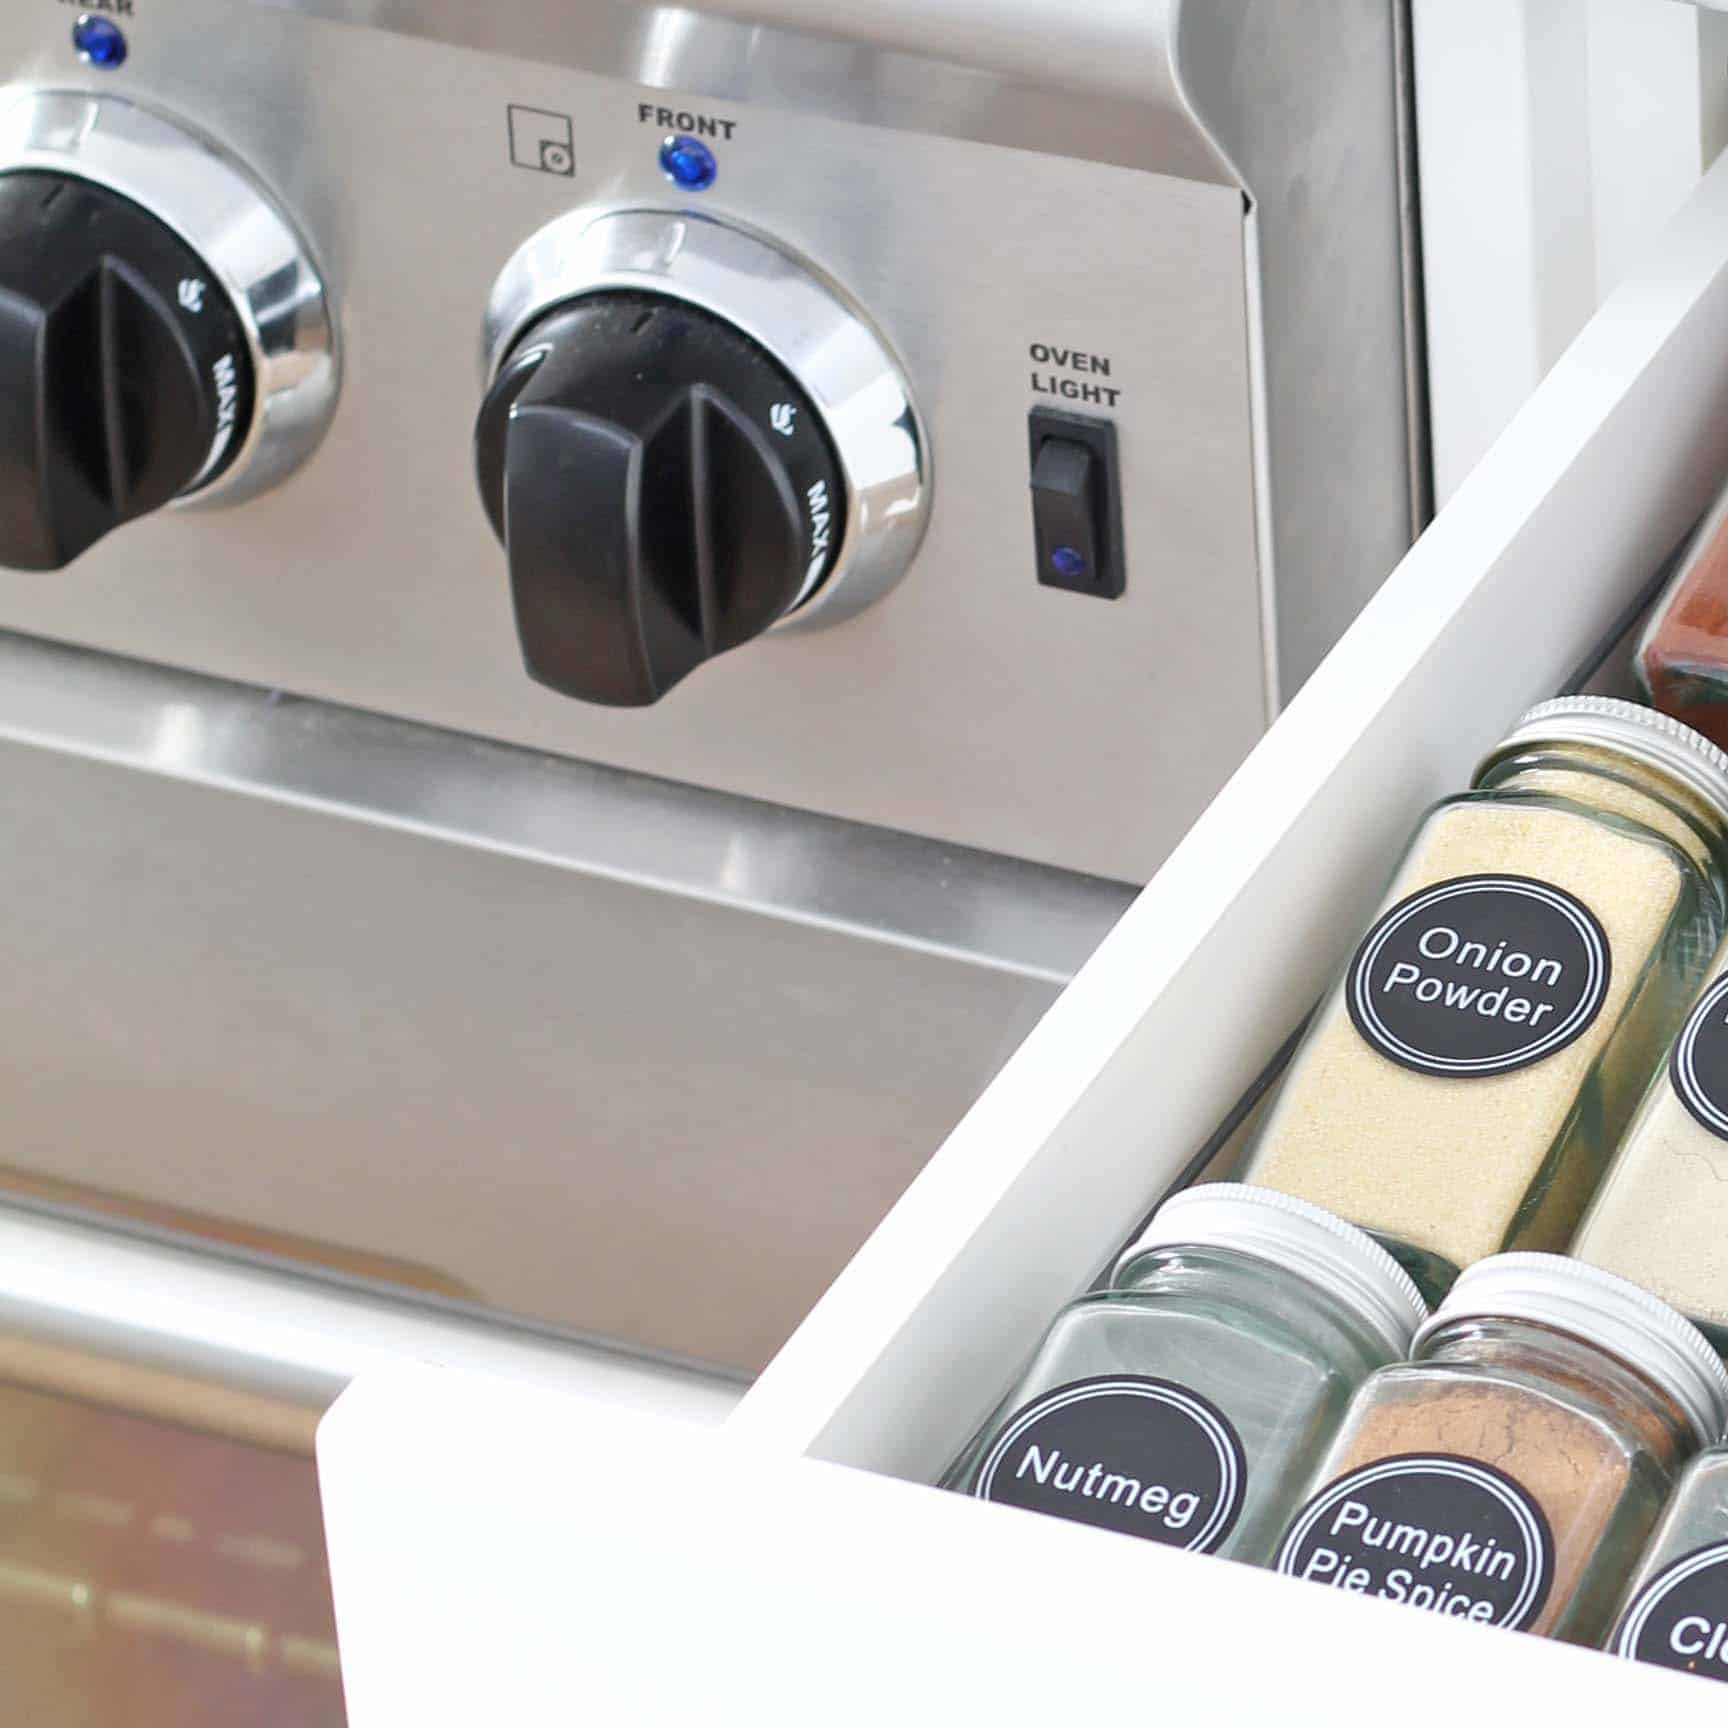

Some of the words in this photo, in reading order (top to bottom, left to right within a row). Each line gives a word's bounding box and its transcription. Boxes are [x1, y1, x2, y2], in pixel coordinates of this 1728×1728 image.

[638, 103, 737, 141] FRONT
[1029, 343, 1111, 377] OVEN
[1031, 372, 1121, 408] LIGHT
[807, 480, 830, 558] MAX
[1418, 927, 1562, 986] Onion
[1383, 962, 1553, 1026] Powder
[1015, 1445, 1201, 1529] Nutmeg
[1330, 1500, 1516, 1581] Pumpkin
